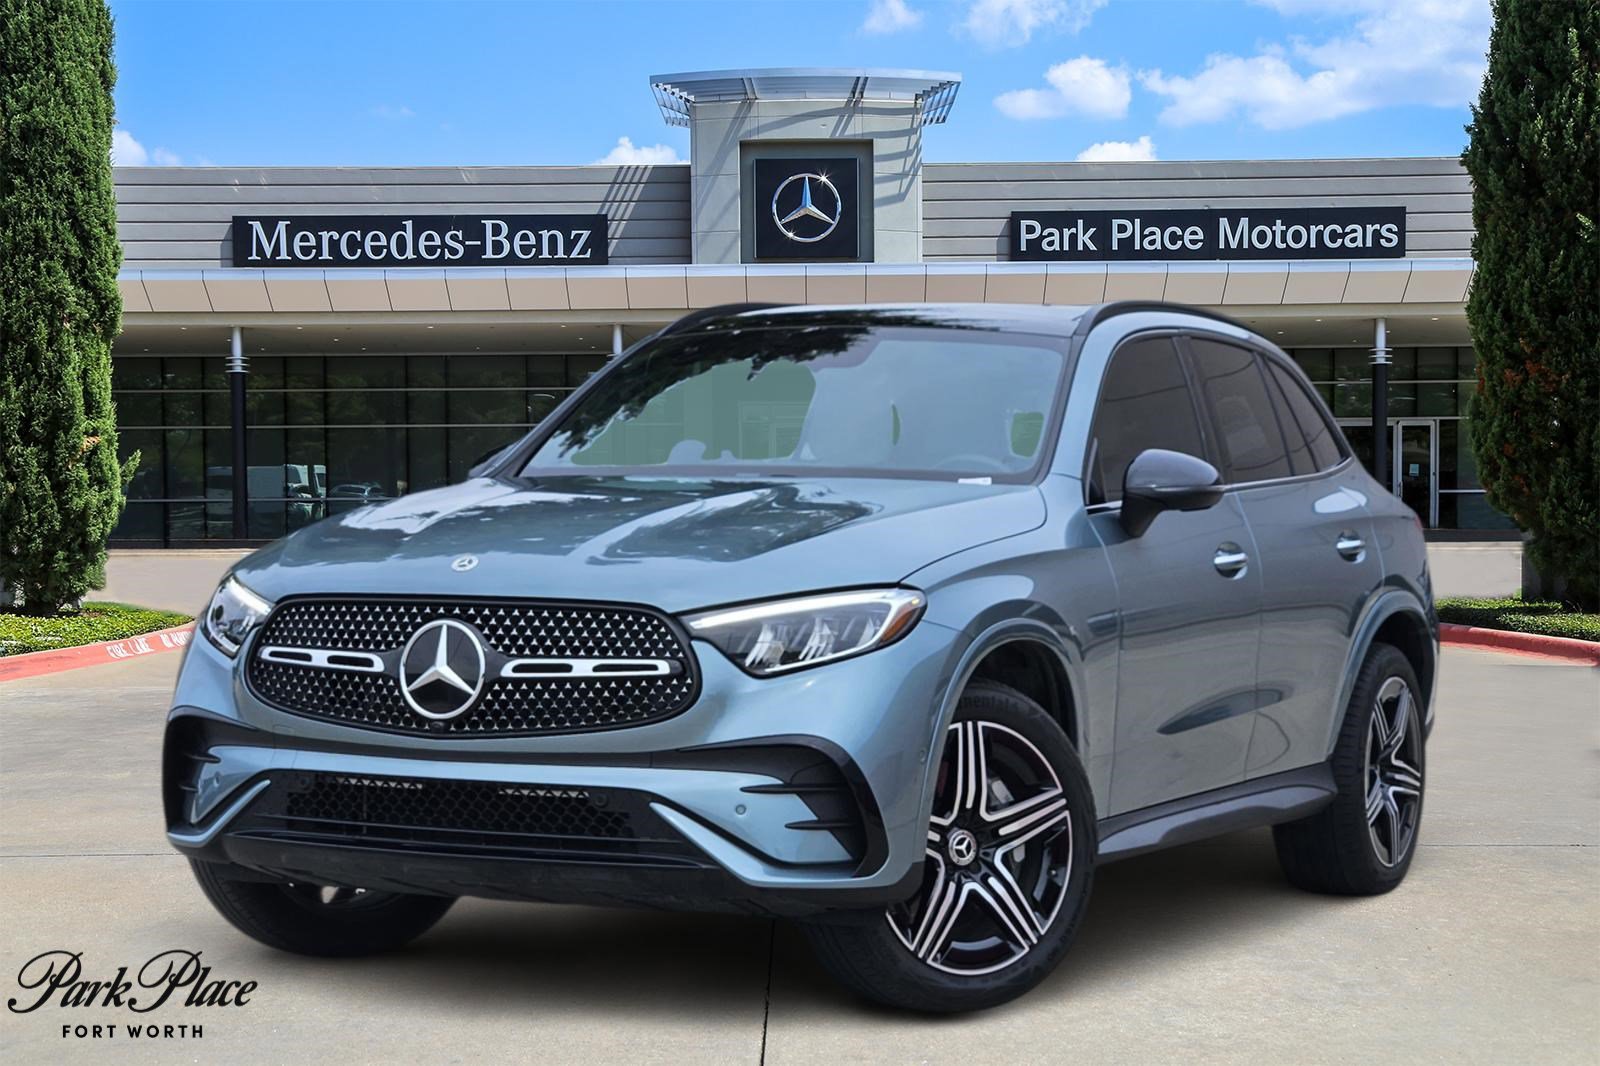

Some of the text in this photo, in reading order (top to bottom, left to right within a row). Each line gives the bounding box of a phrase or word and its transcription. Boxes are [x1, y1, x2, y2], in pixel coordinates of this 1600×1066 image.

[247, 219, 592, 260] Mercedes-Benz
[1020, 216, 1399, 251] Park Place Motorcars
